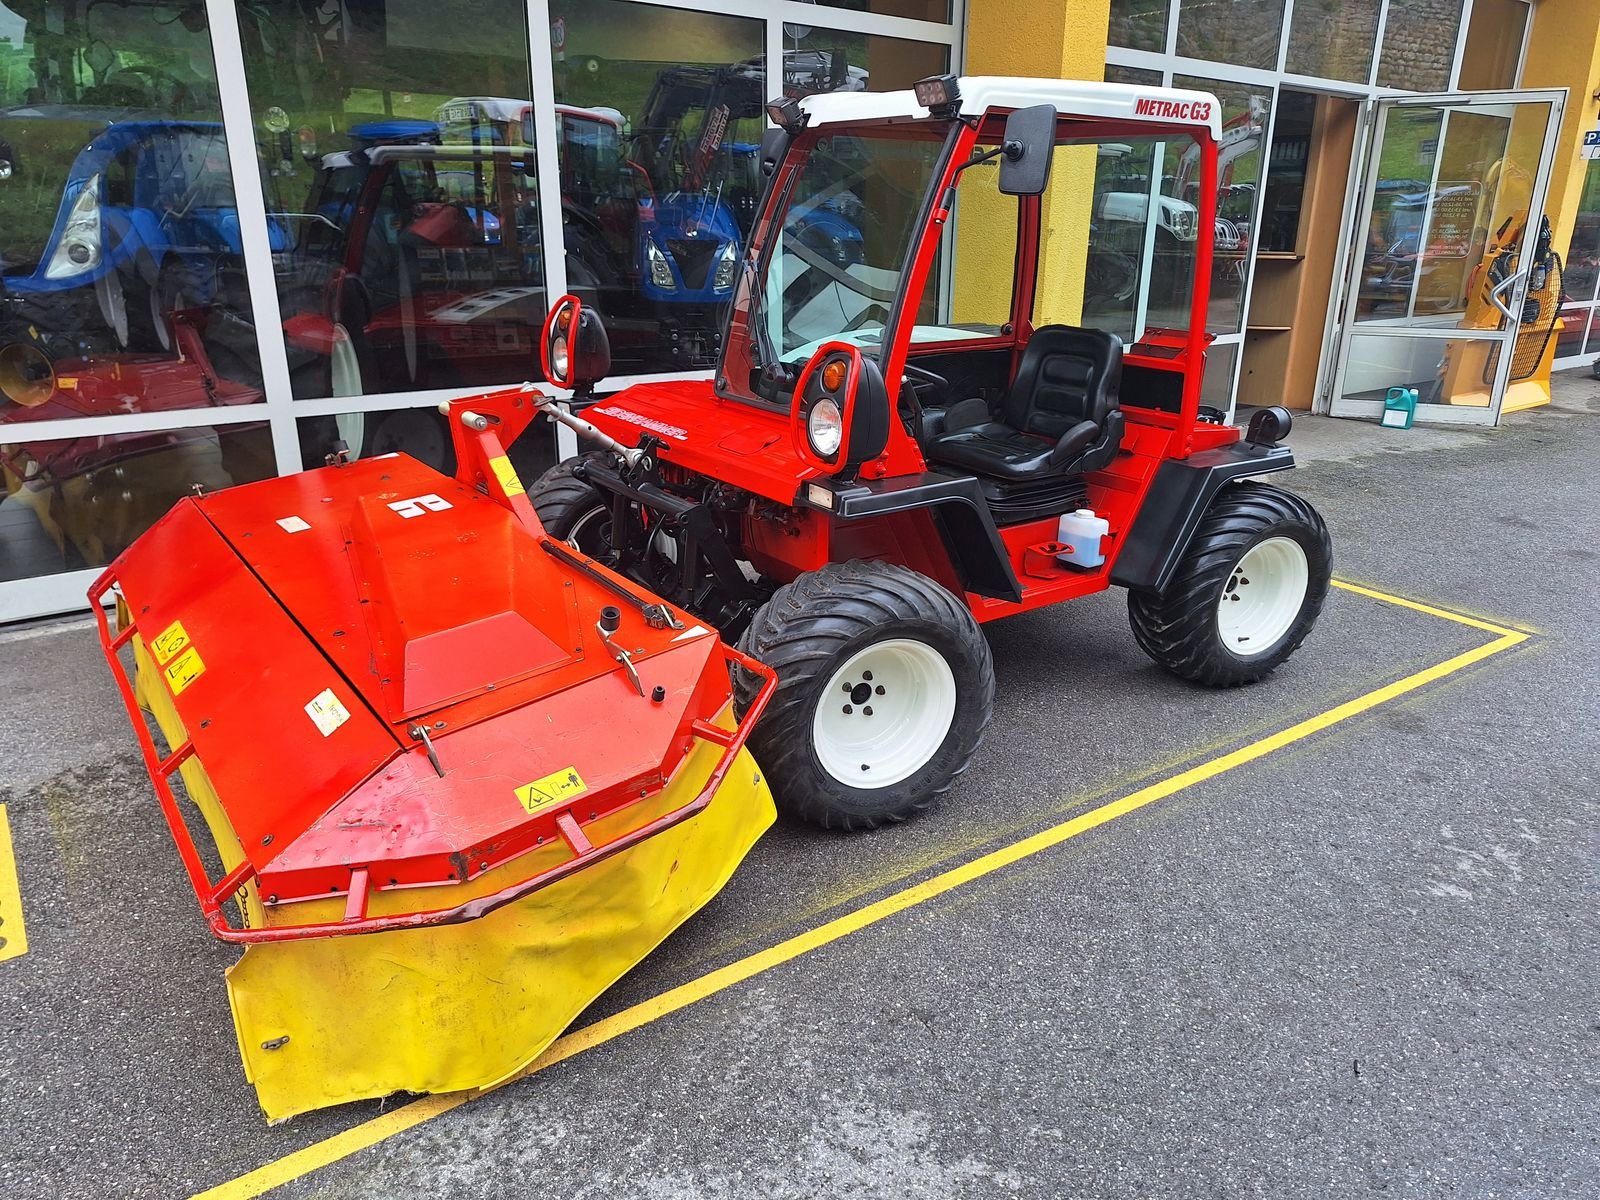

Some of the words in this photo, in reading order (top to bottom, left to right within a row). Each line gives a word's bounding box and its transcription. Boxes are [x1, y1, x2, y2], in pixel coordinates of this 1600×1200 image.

[1135, 99, 1189, 119] METRAC
[1189, 102, 1211, 121] G3
[1587, 132, 1597, 144] P
